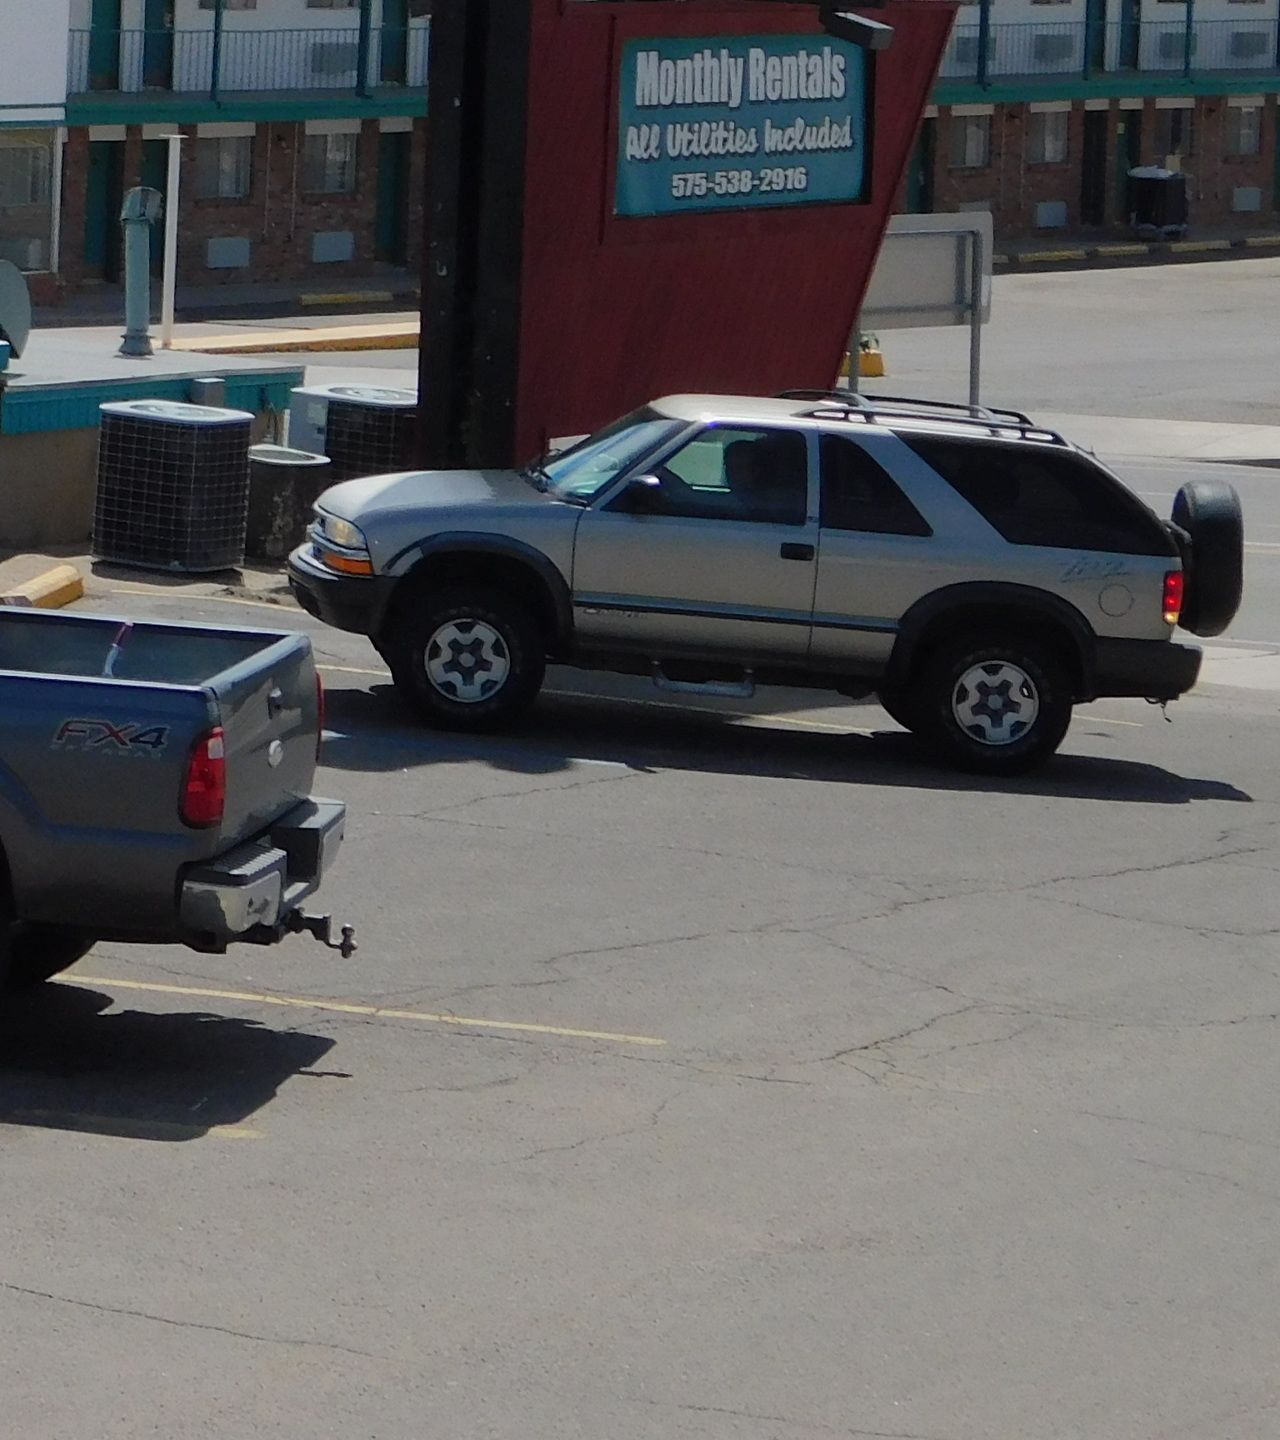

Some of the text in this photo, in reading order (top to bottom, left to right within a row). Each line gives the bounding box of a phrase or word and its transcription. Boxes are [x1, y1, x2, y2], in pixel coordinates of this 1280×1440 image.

[635, 46, 846, 108] Monthly Rentals
[626, 115, 853, 160] All Utilities Included
[671, 166, 808, 198] 575-538-2916
[55, 718, 170, 749] FX4
